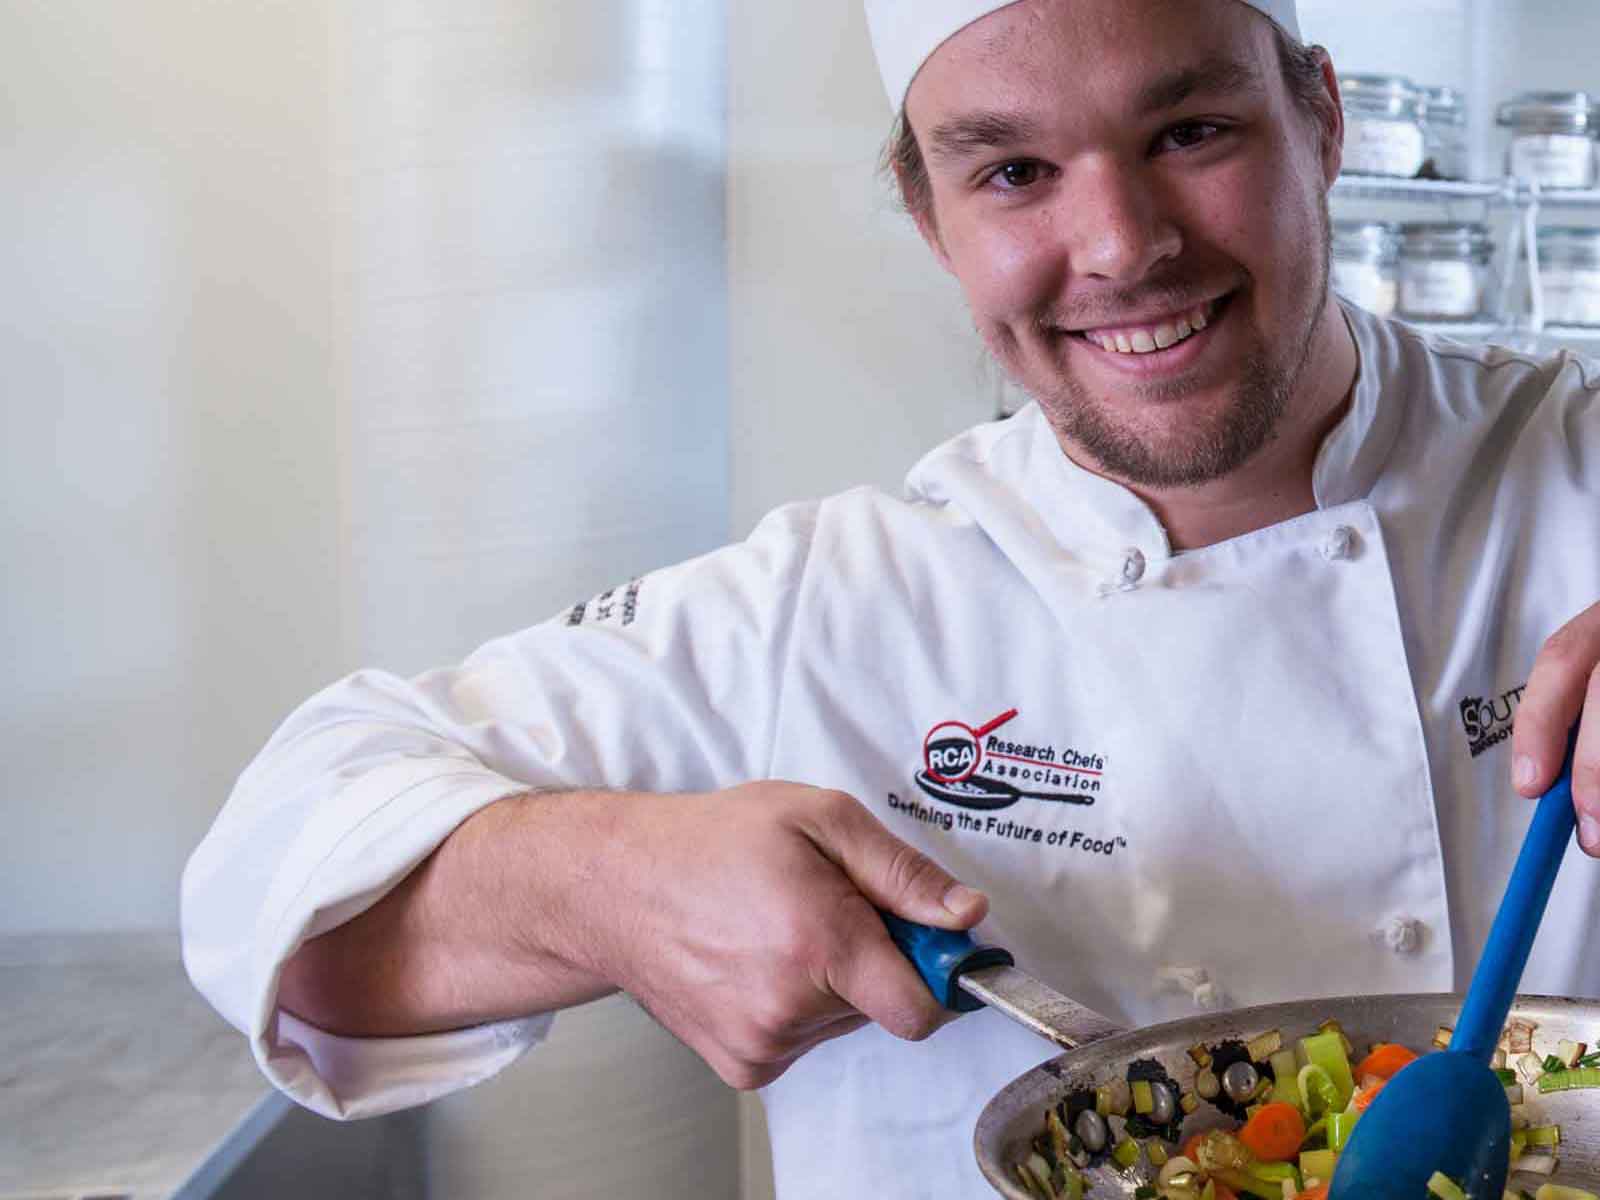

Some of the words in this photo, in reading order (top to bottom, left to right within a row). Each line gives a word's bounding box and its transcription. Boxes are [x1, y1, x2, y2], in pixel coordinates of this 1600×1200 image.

[928, 745, 974, 769] RCA
[986, 735, 1055, 762] Research
[982, 759, 1101, 792] Association
[887, 792, 953, 831] Defining
[957, 811, 982, 832] the
[985, 817, 1042, 843] Future
[1049, 829, 1067, 846] of
